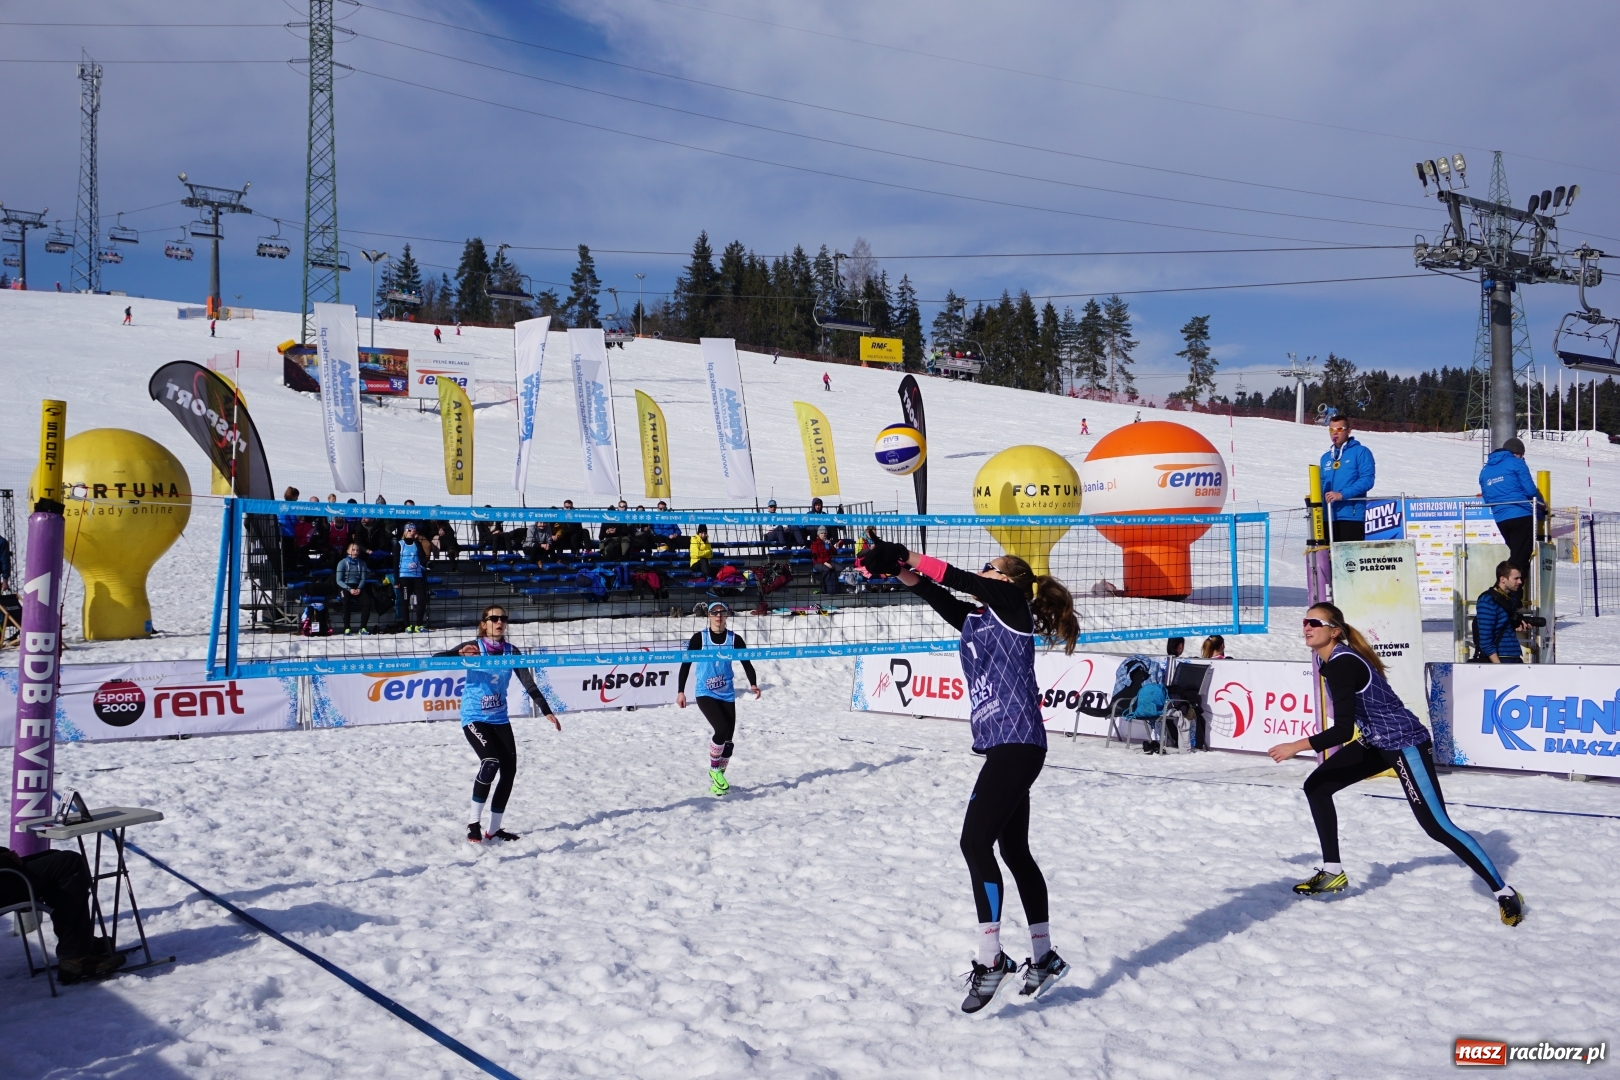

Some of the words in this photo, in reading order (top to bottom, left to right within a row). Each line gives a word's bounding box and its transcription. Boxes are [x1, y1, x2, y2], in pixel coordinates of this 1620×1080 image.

[1153, 463, 1222, 489] Terma
[132, 504, 173, 515] online
[1409, 502, 1458, 511] MISTRZOSTWA
[1359, 555, 1403, 565] SIATKÓWKA
[1360, 563, 1396, 572] PLAŻOWA
[966, 641, 978, 659] 1
[22, 632, 55, 705] BDB
[582, 671, 669, 691] rhSPORT
[890, 658, 964, 707] RULES
[98, 692, 141, 703] SPORT
[153, 681, 245, 718] rent
[101, 702, 138, 713] 2000
[15, 718, 50, 833] EVEN
